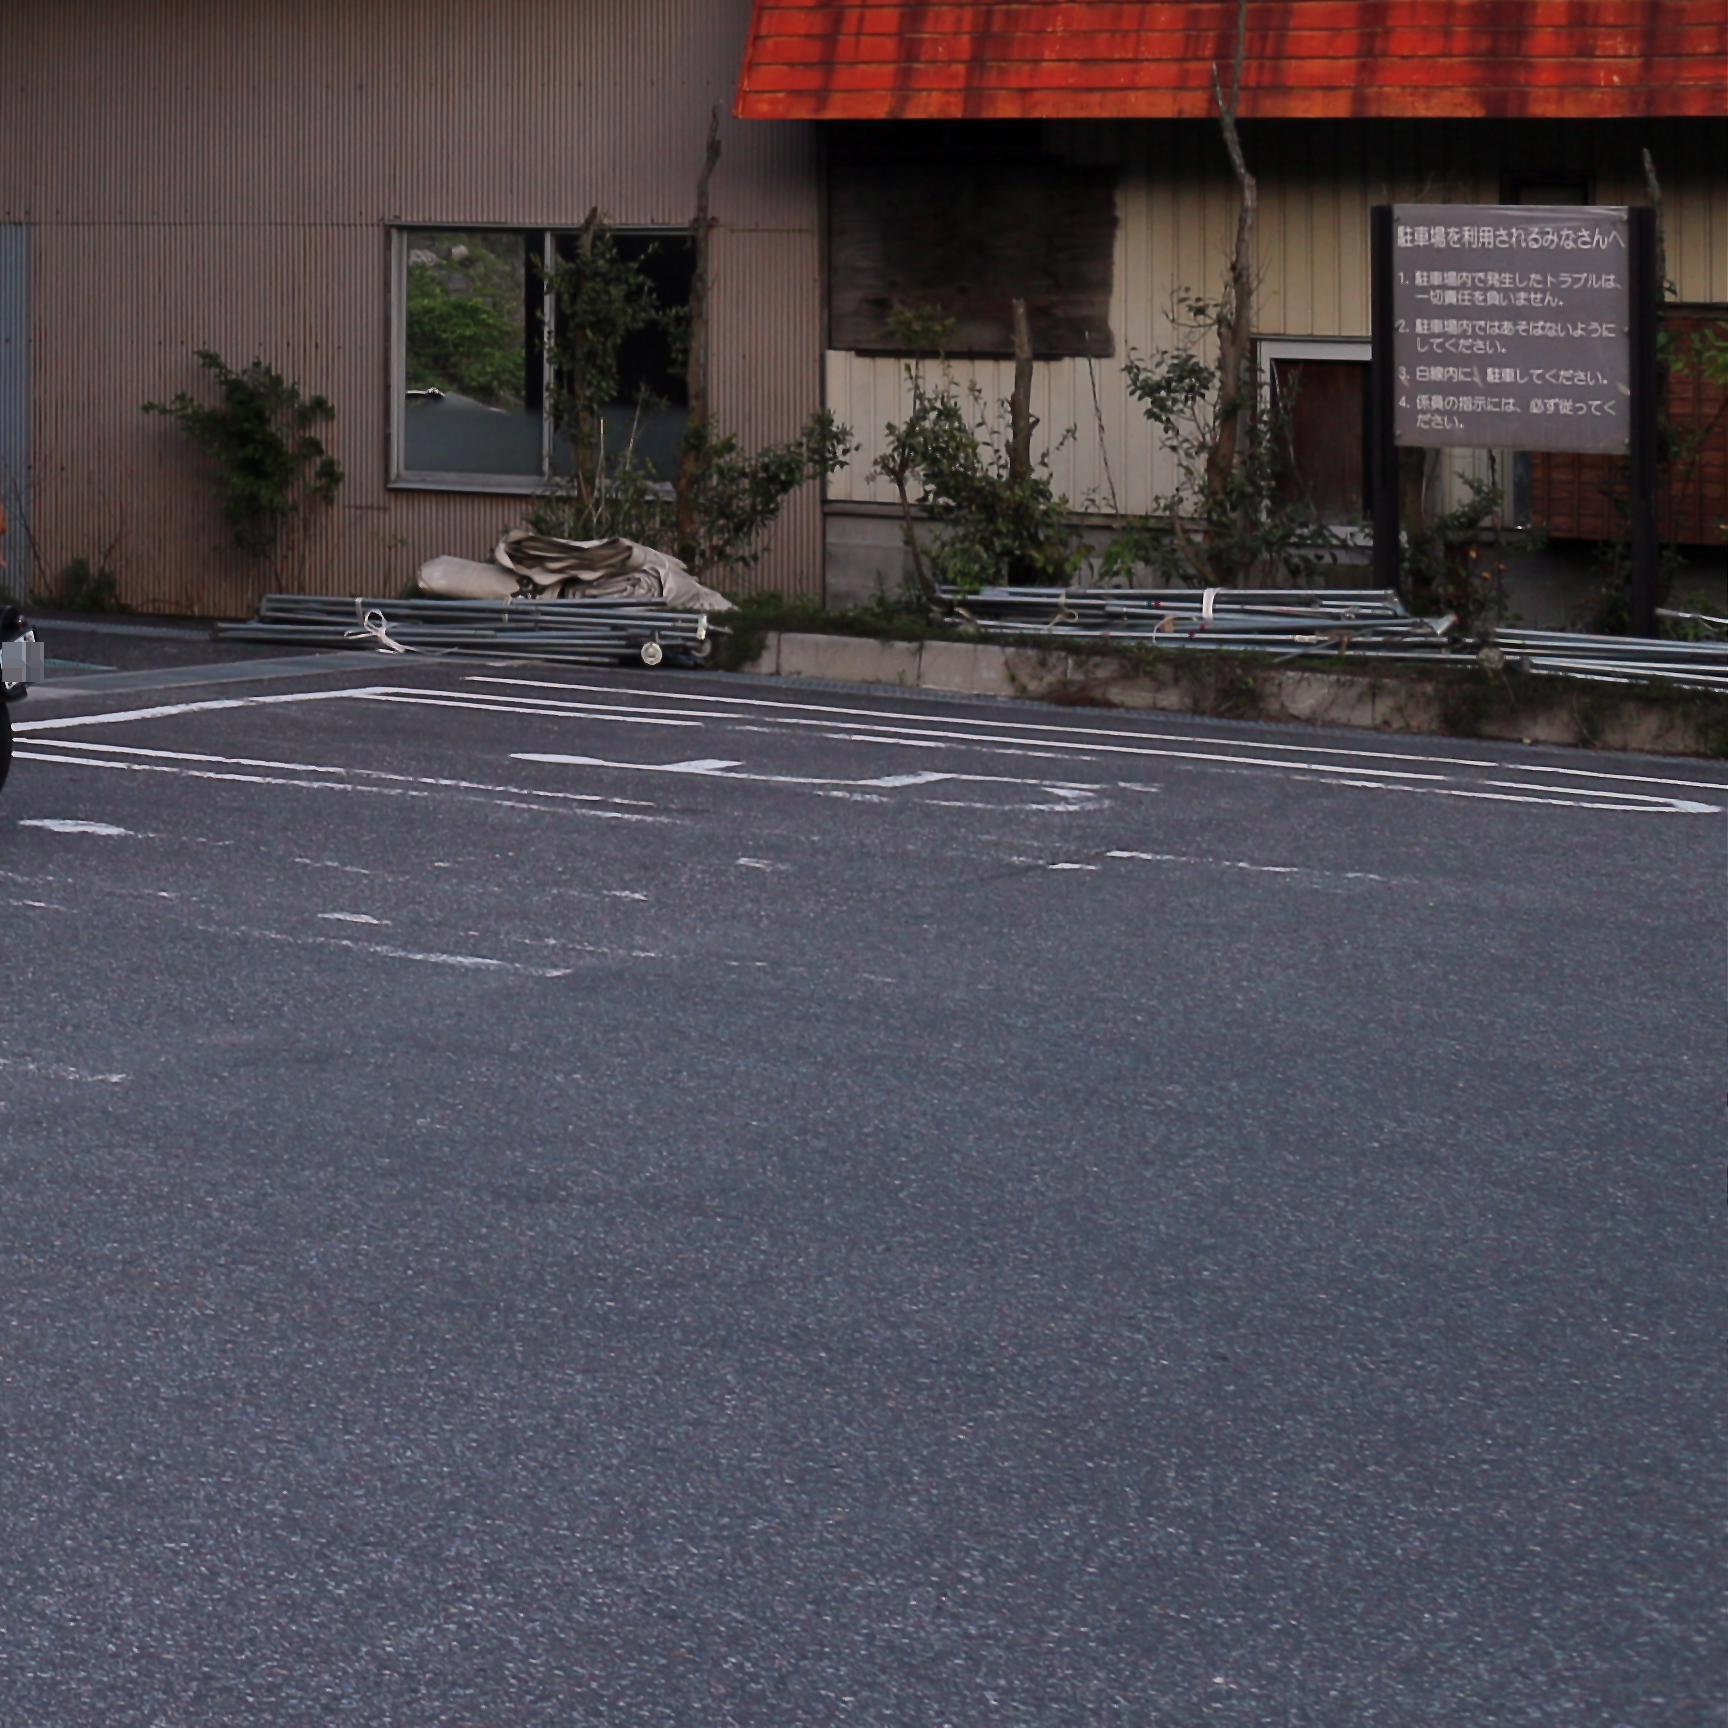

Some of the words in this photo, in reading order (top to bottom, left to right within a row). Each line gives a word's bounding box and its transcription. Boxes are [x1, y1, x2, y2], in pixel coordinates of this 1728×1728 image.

[1397, 225, 1626, 250] 駐車場を利用されるみなさんへ
[1415, 271, 1622, 289] 駐車場内で発生したトラブルは、
[1415, 290, 1564, 307] 一切責任を負いません。
[1415, 319, 1616, 337] 駐車場内ではあそばないように
[1416, 337, 1506, 354] してください。
[1416, 415, 1463, 429] ださい。
